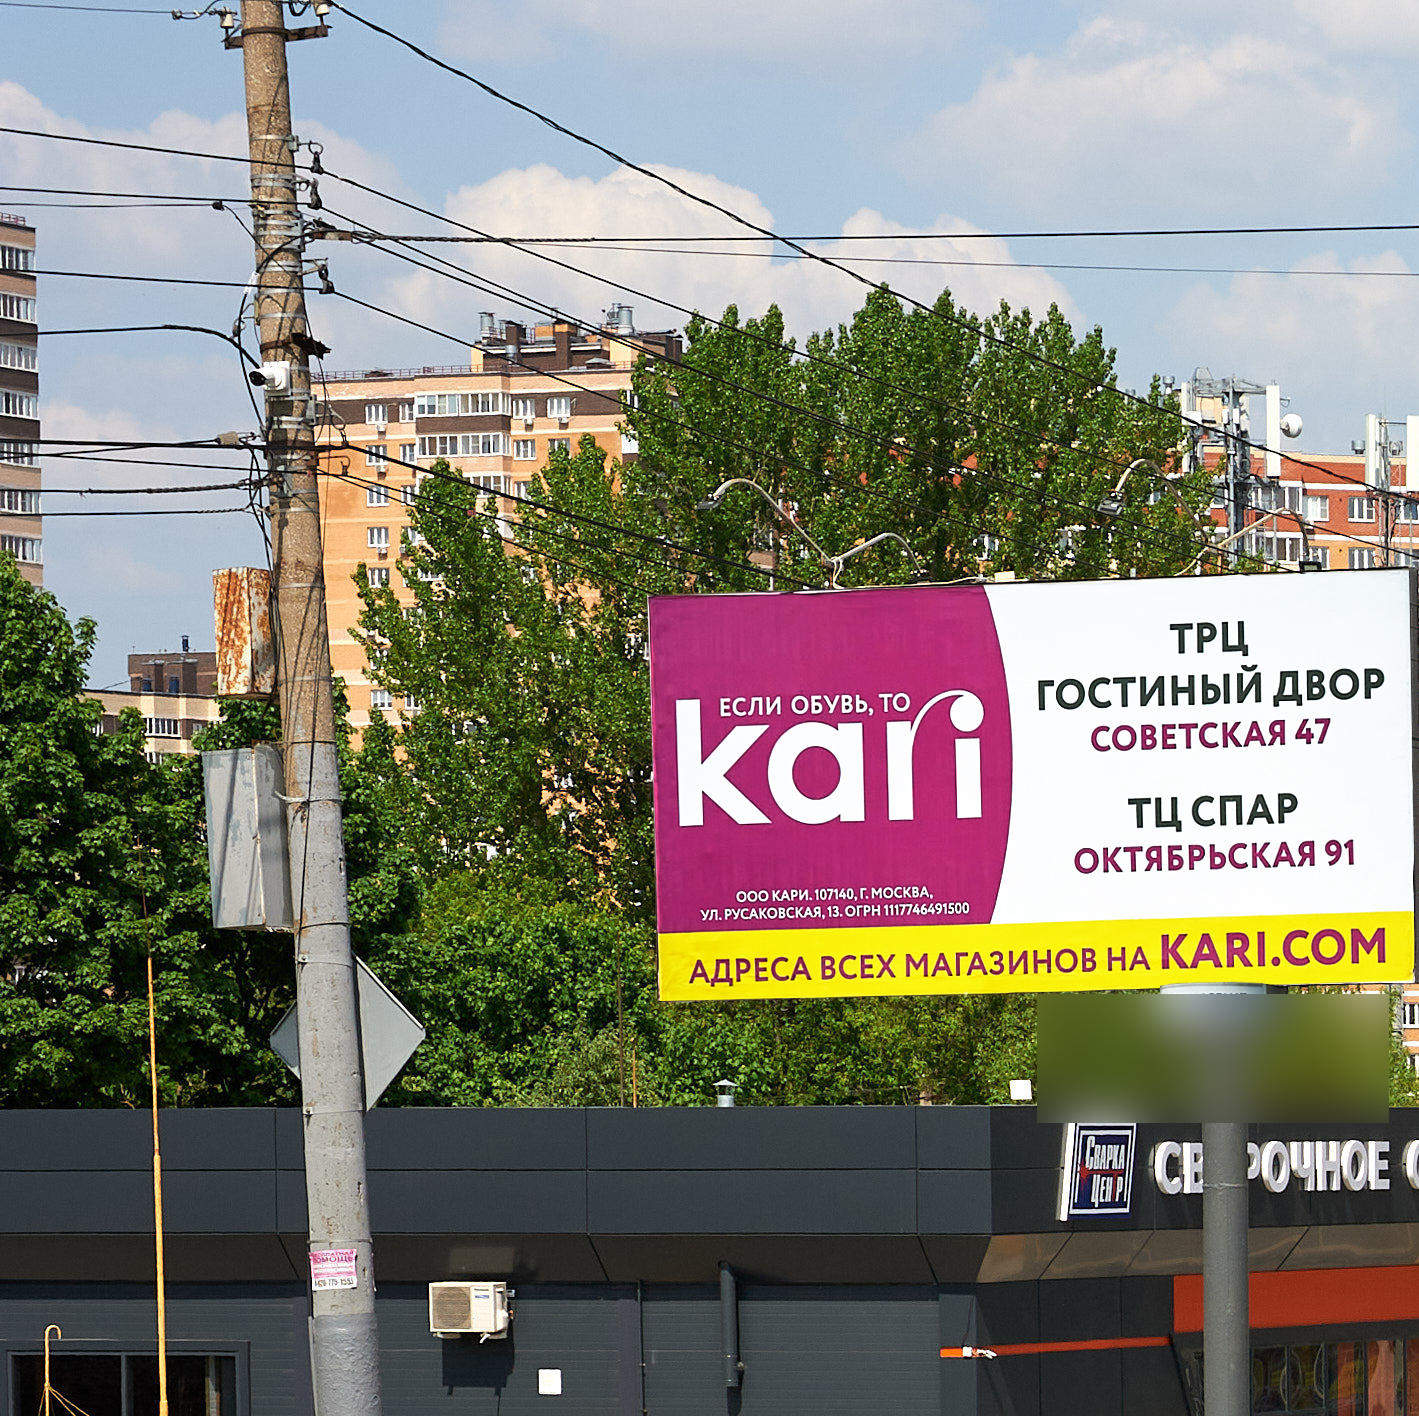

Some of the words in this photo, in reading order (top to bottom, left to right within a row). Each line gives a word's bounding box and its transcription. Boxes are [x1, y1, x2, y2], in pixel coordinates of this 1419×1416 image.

[1170, 621, 1249, 656] ТРЦ
[719, 697, 782, 717] ЕСЛИ
[790, 695, 874, 716] ОБУВЬ,
[879, 693, 911, 712] ТО
[1038, 664, 1262, 711] ГОСТИНЫЙ
[1273, 668, 1385, 707] ДВОР
[1091, 719, 1286, 752] СОВЕТСКАЯ
[1295, 718, 1331, 745] 47
[675, 689, 984, 827] kari
[1128, 797, 1182, 832] ТЦ
[1191, 793, 1298, 827] СПАР
[1074, 841, 1315, 874] ОКТЯБРЬСКАЯ
[1325, 839, 1355, 866] 91
[700, 908, 722, 921] УЛ.
[724, 906, 825, 920] РУСАКОВСКАЯ,
[827, 906, 843, 918] 13.
[845, 904, 881, 917] ОГРН
[884, 902, 970, 916] 1117746491500
[736, 890, 769, 903] ООО
[772, 889, 813, 902] КАРИ.
[814, 888, 857, 902] 107140,
[860, 888, 870, 900] Г.
[871, 886, 933, 900] МОСКВА,
[689, 956, 812, 987] АДРЕСА
[821, 954, 896, 981] ВСЕХ
[905, 948, 1096, 979] МАГАЗИНОВ
[1107, 946, 1150, 971] НА
[1161, 927, 1386, 970] KARI.COM
[1153, 1140, 1391, 1195] СВРОЧНОЕ
